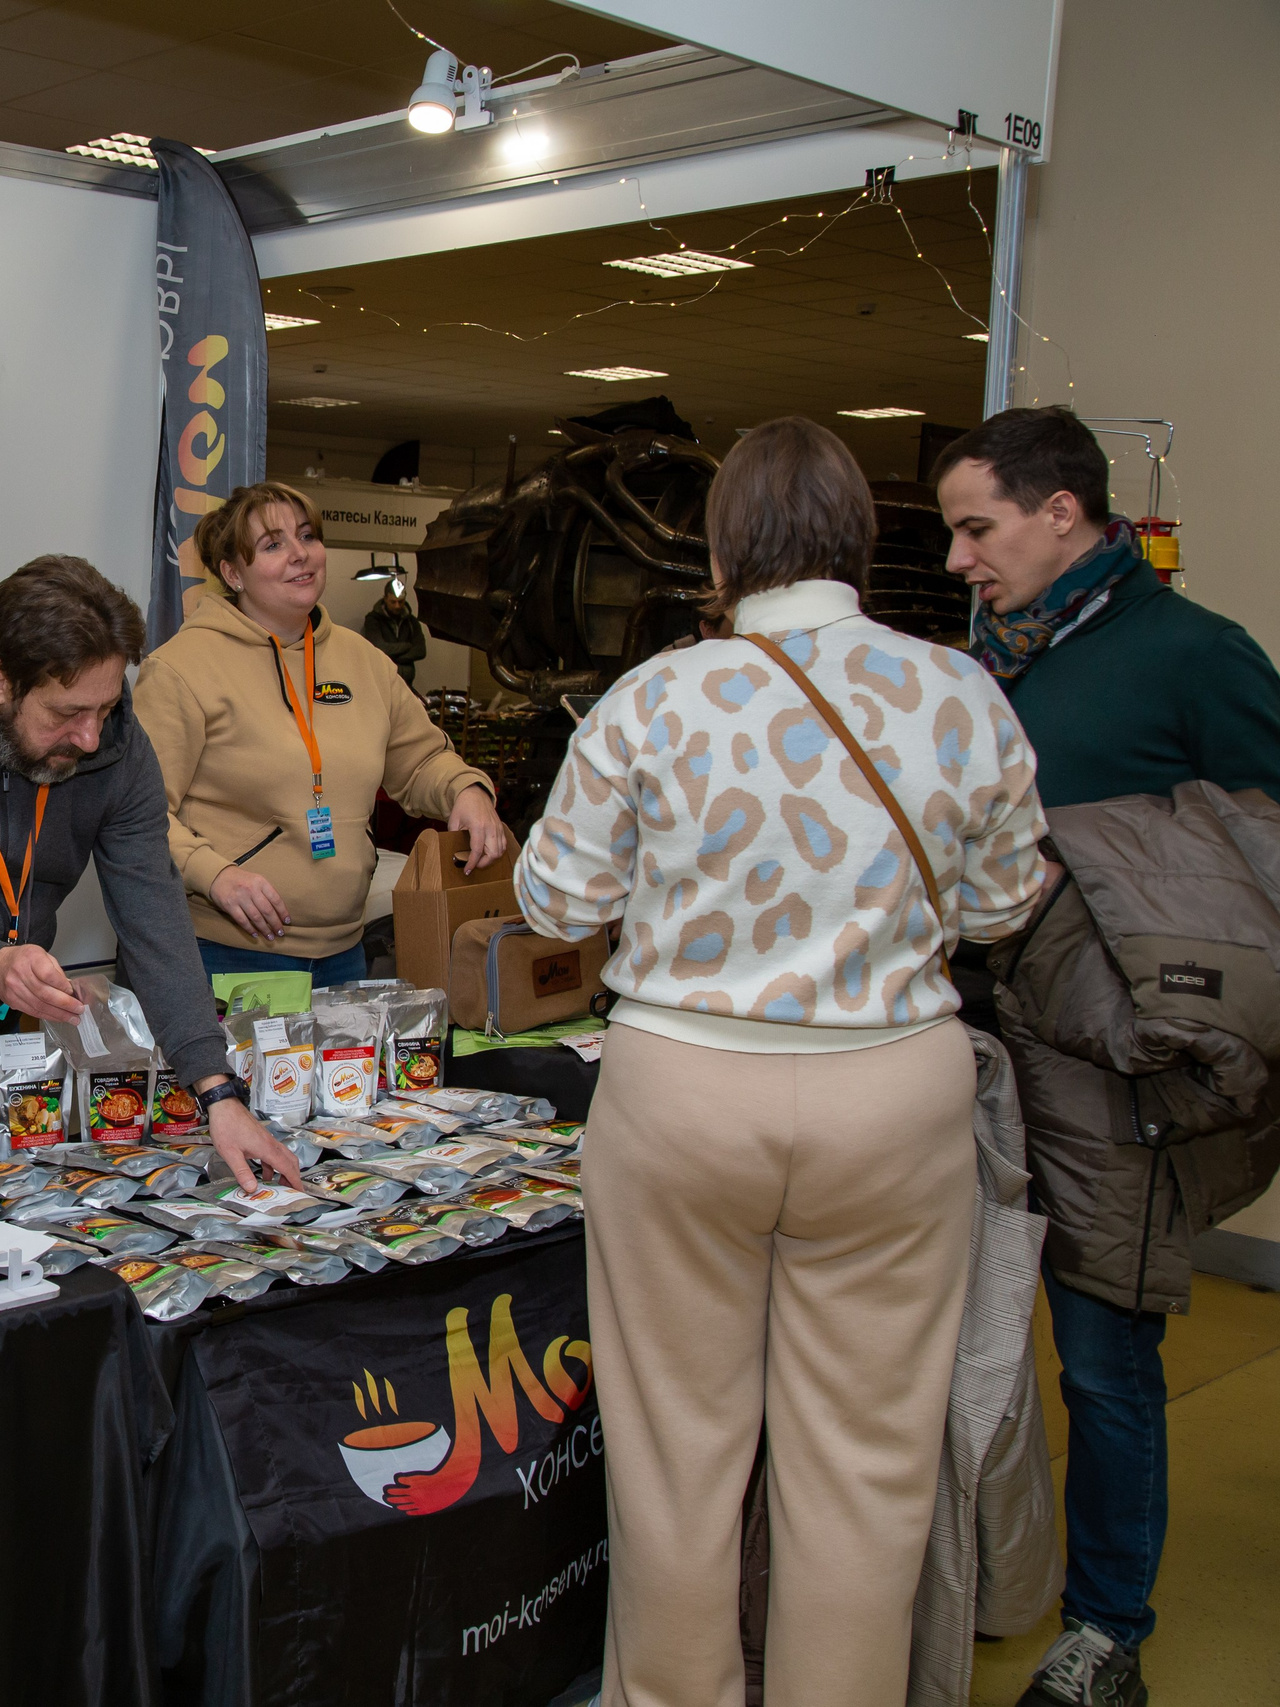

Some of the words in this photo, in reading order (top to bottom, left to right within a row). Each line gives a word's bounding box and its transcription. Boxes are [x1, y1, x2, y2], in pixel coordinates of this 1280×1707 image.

[1004, 112, 1041, 150] 1E09
[374, 510, 417, 527] Казани
[440, 1293, 595, 1460] Мо
[516, 1414, 604, 1510] консе
